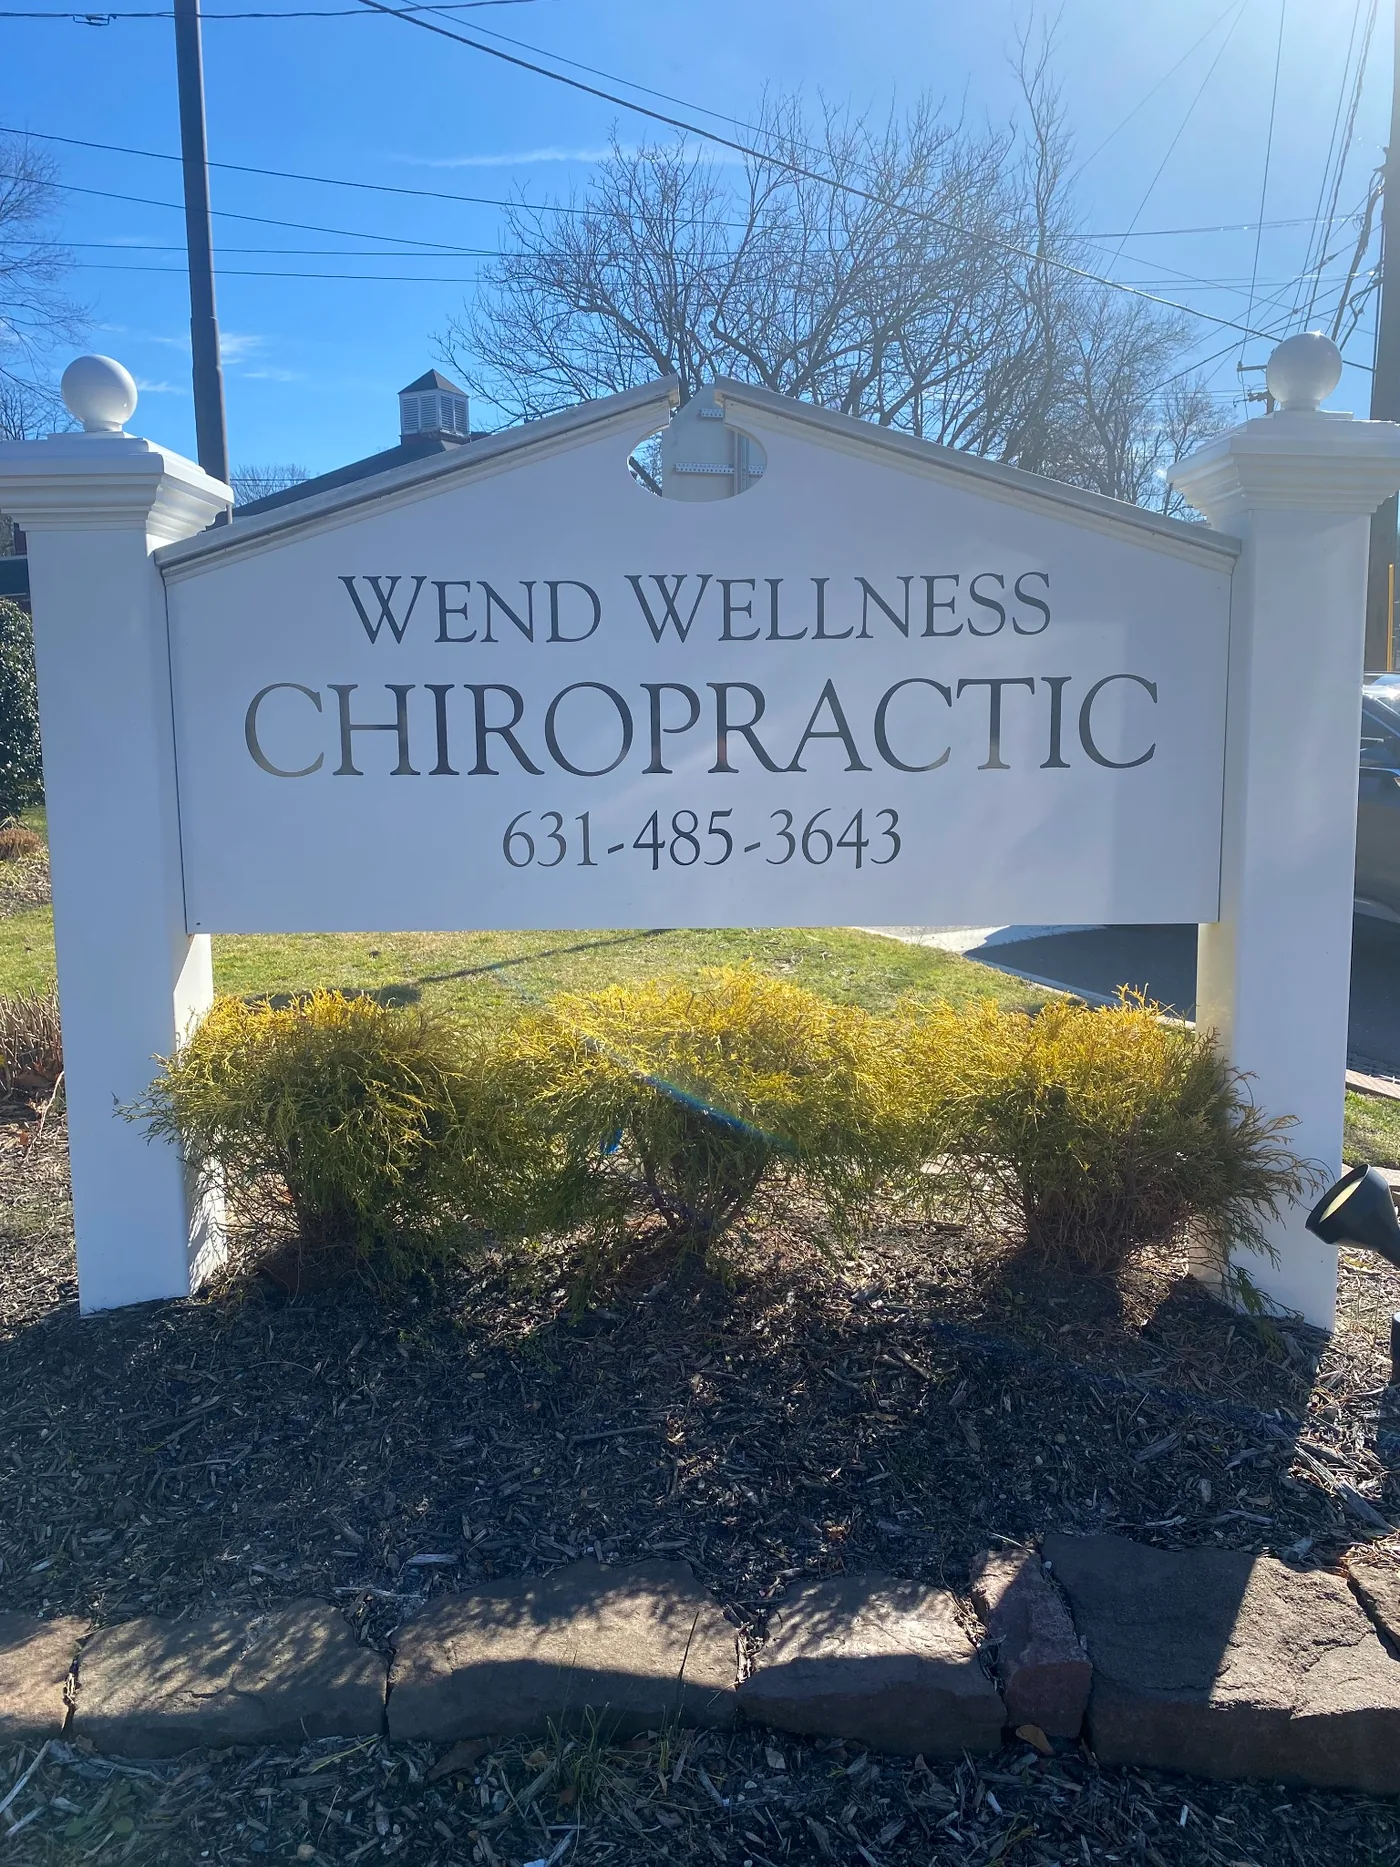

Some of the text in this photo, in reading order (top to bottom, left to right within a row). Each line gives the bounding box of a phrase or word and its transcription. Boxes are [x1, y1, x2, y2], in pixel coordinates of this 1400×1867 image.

[338, 572, 1050, 644] WEND WELLNESS
[245, 674, 1158, 778] CHIROPRACTIC
[503, 808, 902, 870] 631-485-3643
